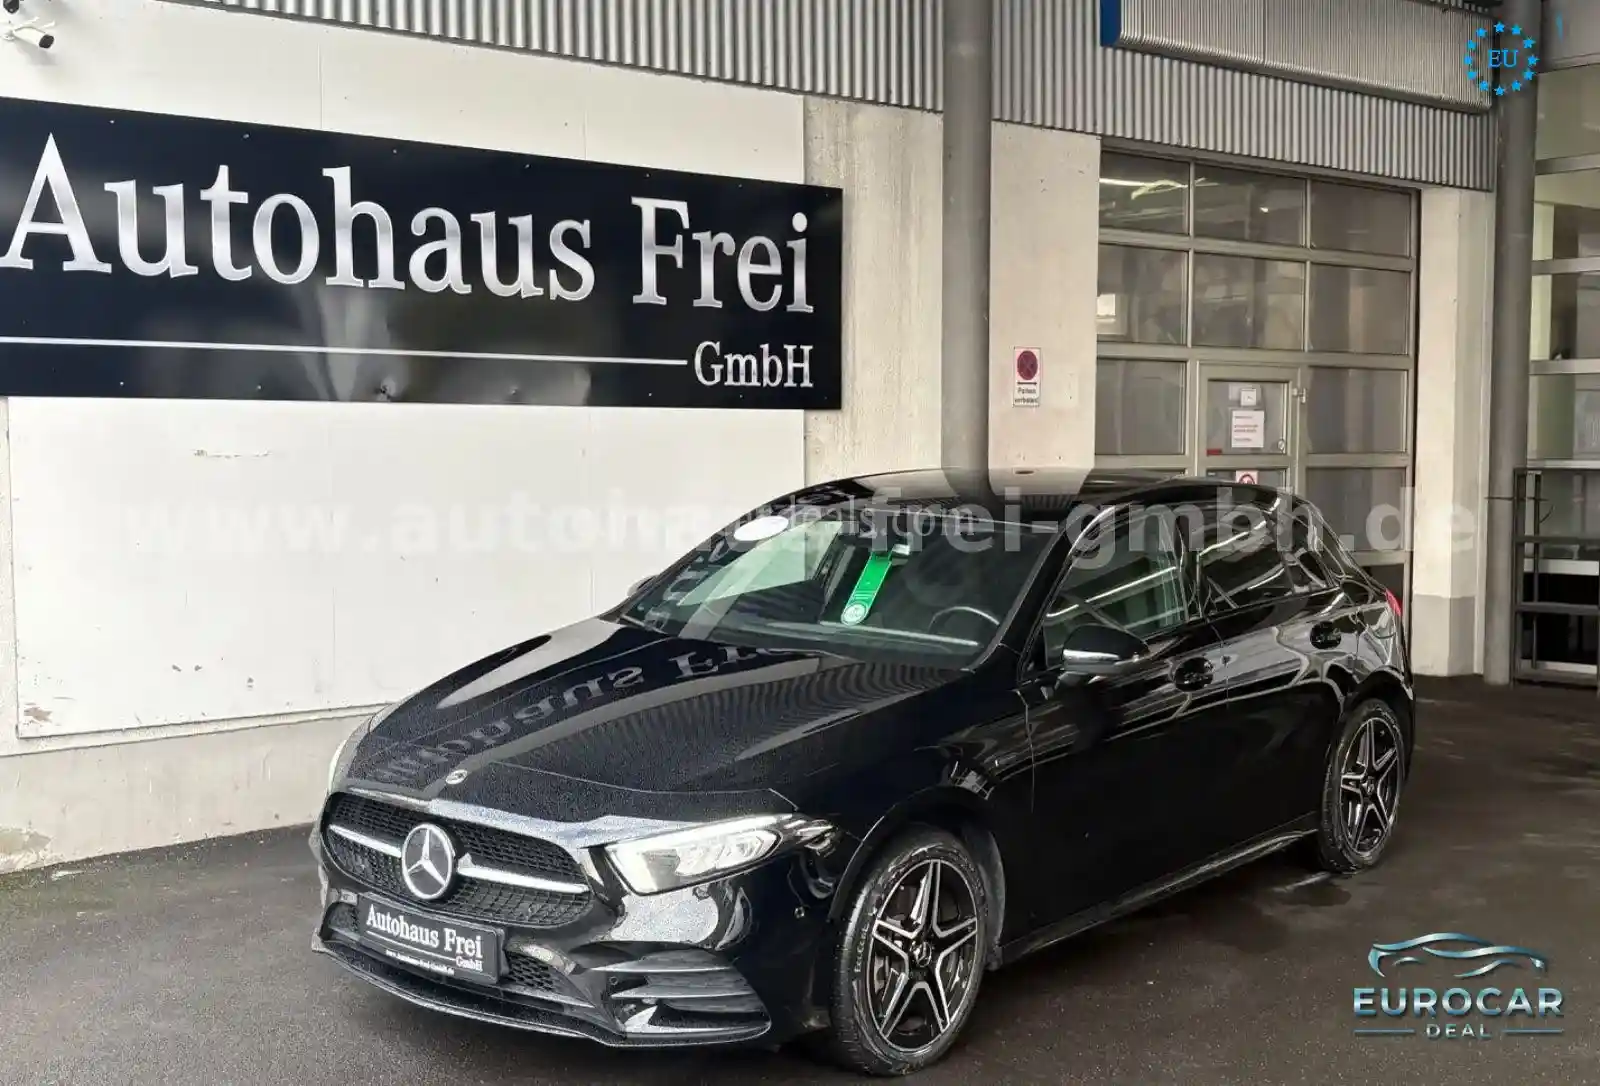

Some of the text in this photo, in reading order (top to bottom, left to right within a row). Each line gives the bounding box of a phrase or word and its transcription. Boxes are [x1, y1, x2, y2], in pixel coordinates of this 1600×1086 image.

[0, 132, 814, 313] Autohaus Frei
[694, 341, 814, 388] GmbH
[366, 903, 484, 959] Autohaus Frei
[455, 955, 484, 973] GmbH
